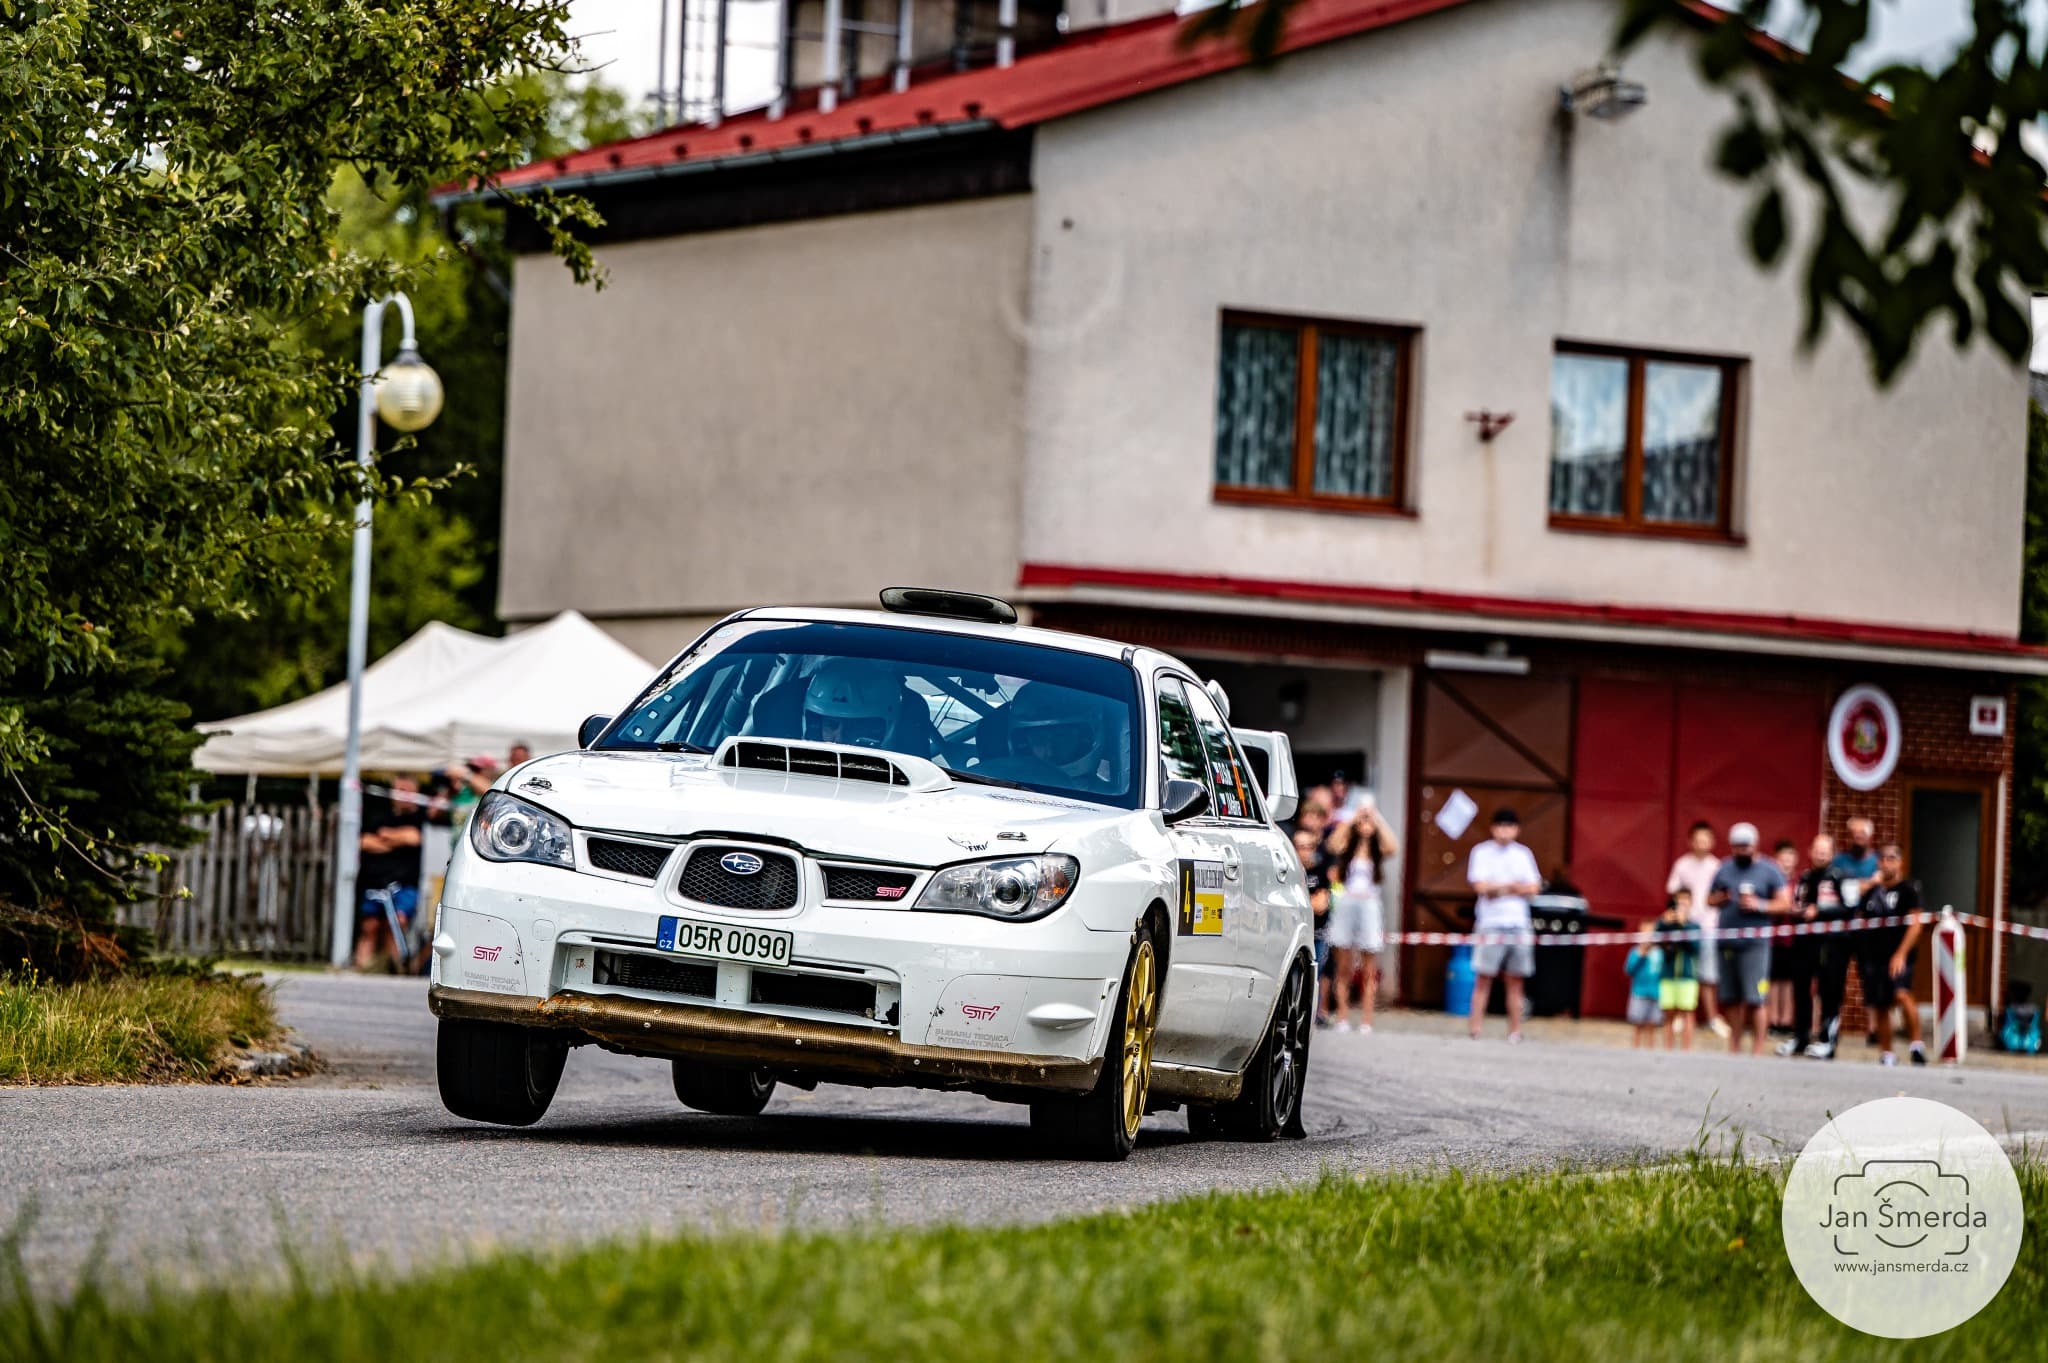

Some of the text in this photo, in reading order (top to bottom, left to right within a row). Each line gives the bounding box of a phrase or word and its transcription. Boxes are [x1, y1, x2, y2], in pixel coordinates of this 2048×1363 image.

[659, 939, 673, 949] CZ
[679, 924, 787, 961] 05R 0090
[974, 1033, 1009, 1042] TECNICA
